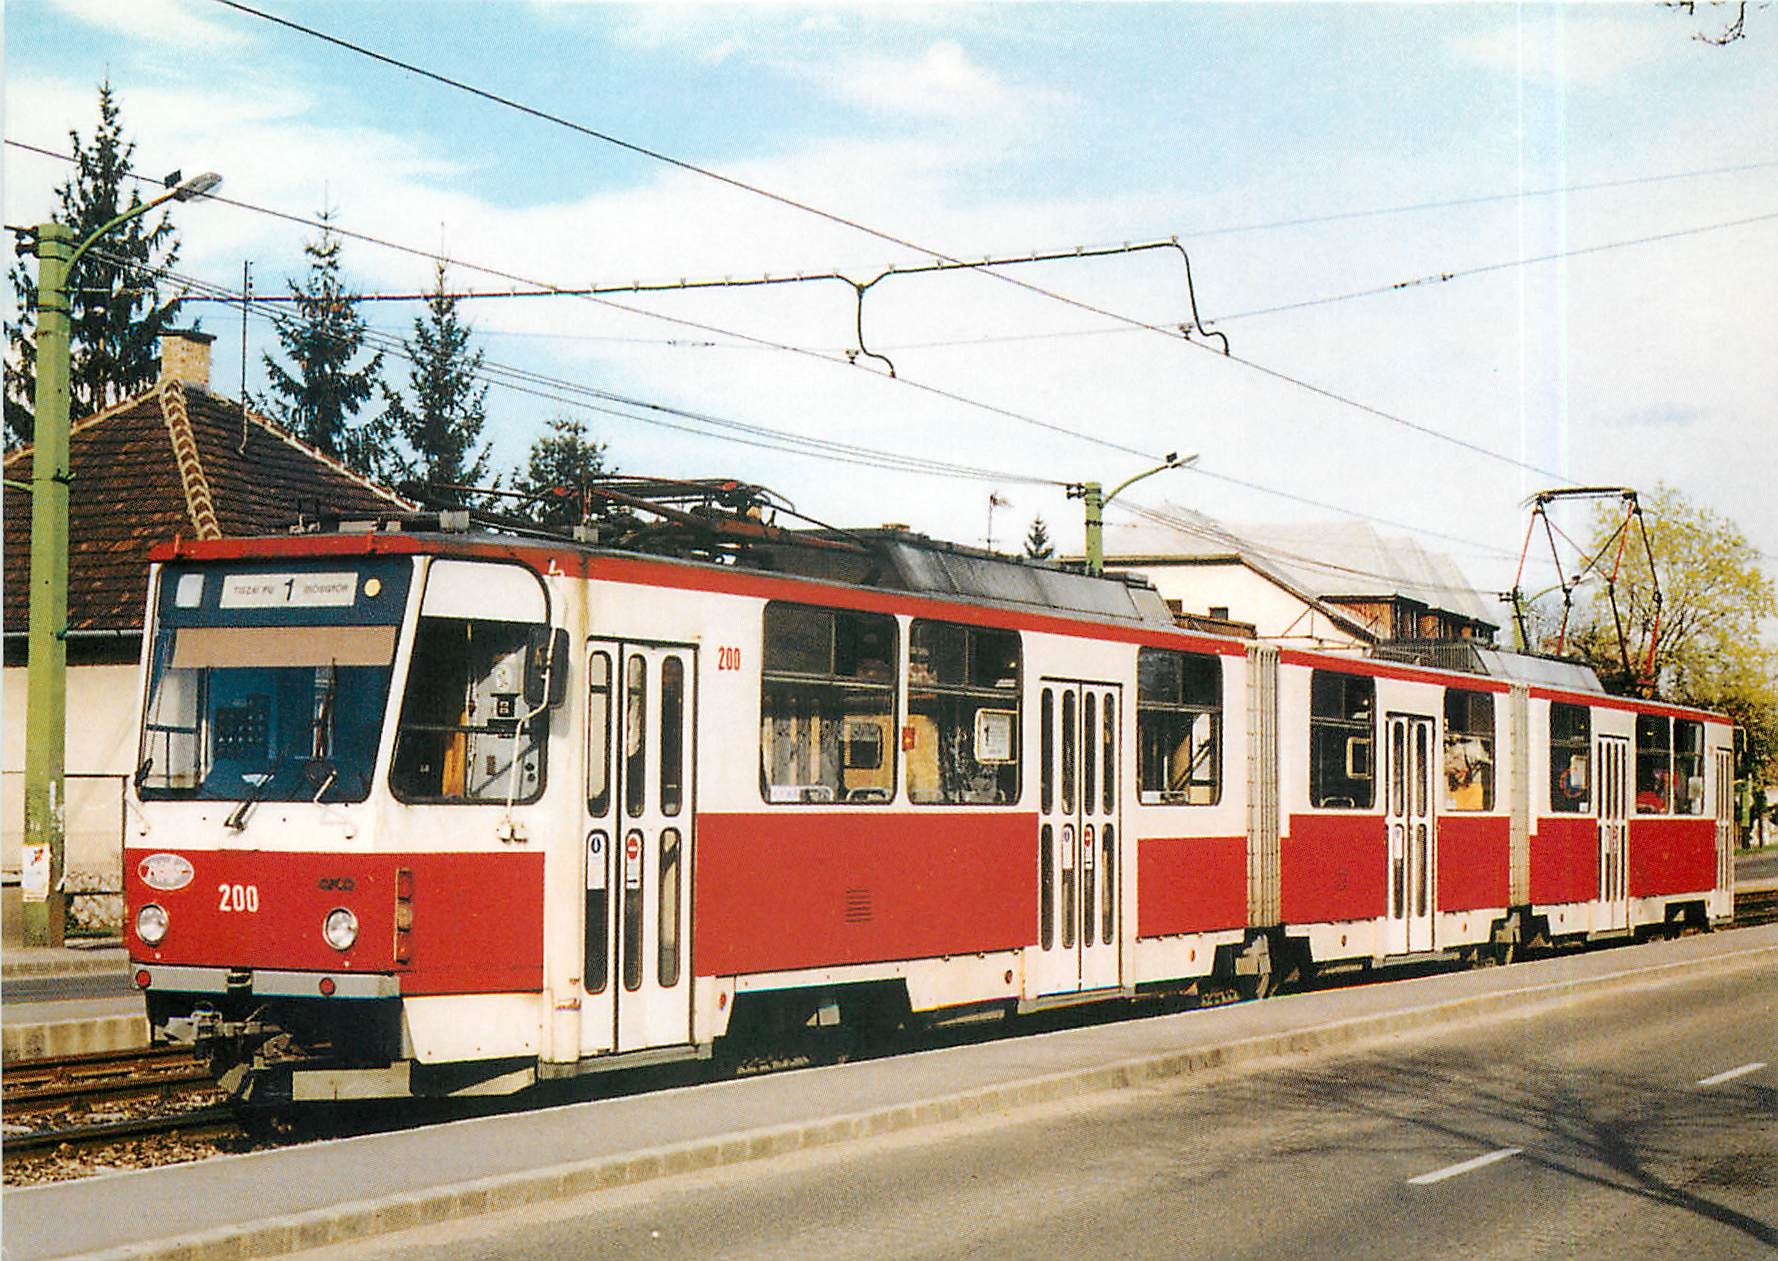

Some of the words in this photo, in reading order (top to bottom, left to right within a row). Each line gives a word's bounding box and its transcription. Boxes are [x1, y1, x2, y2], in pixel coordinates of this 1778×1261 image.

[284, 578, 294, 601] 1
[718, 645, 741, 671] 200
[218, 884, 259, 912] 200
